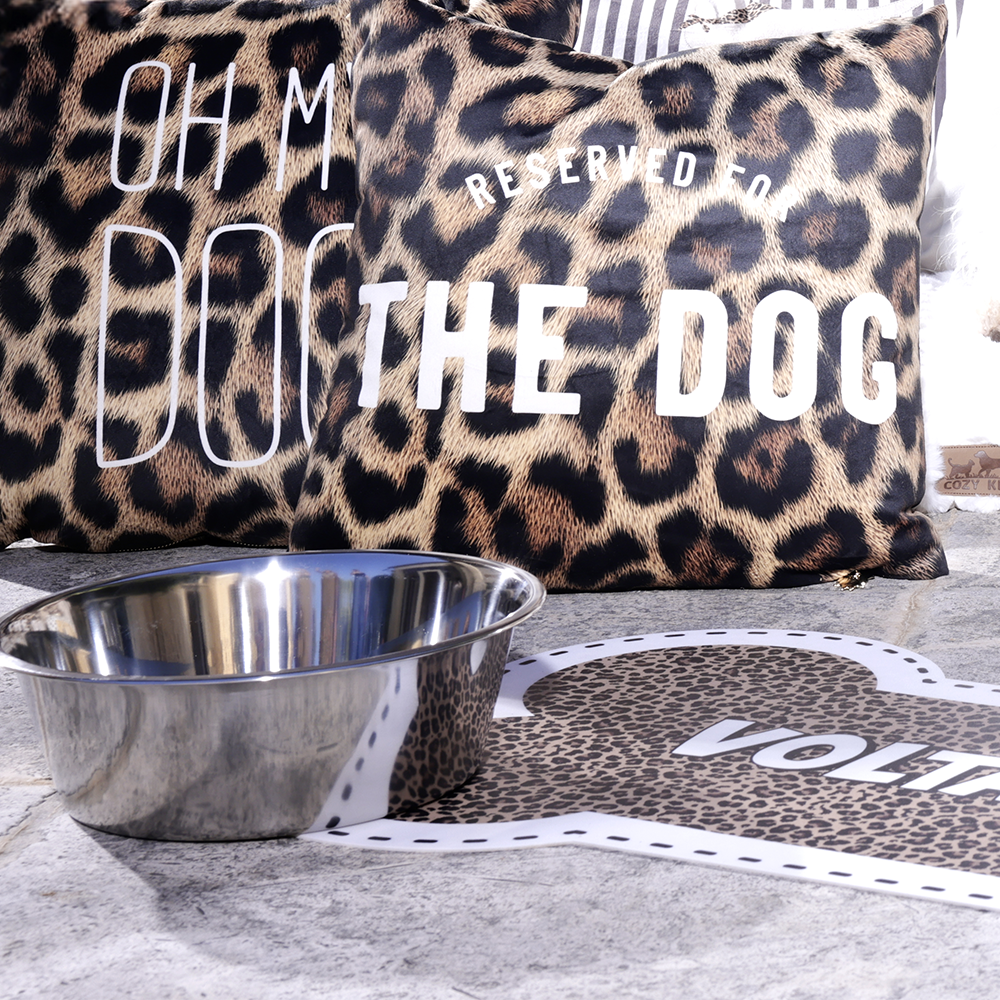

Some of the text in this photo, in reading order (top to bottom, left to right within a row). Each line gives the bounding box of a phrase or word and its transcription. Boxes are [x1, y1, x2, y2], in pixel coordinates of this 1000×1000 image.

[110, 60, 353, 192] OH M
[464, 144, 801, 224] RESERVED FOR
[357, 280, 899, 425] THE DOG
[943, 479, 980, 491] COZY
